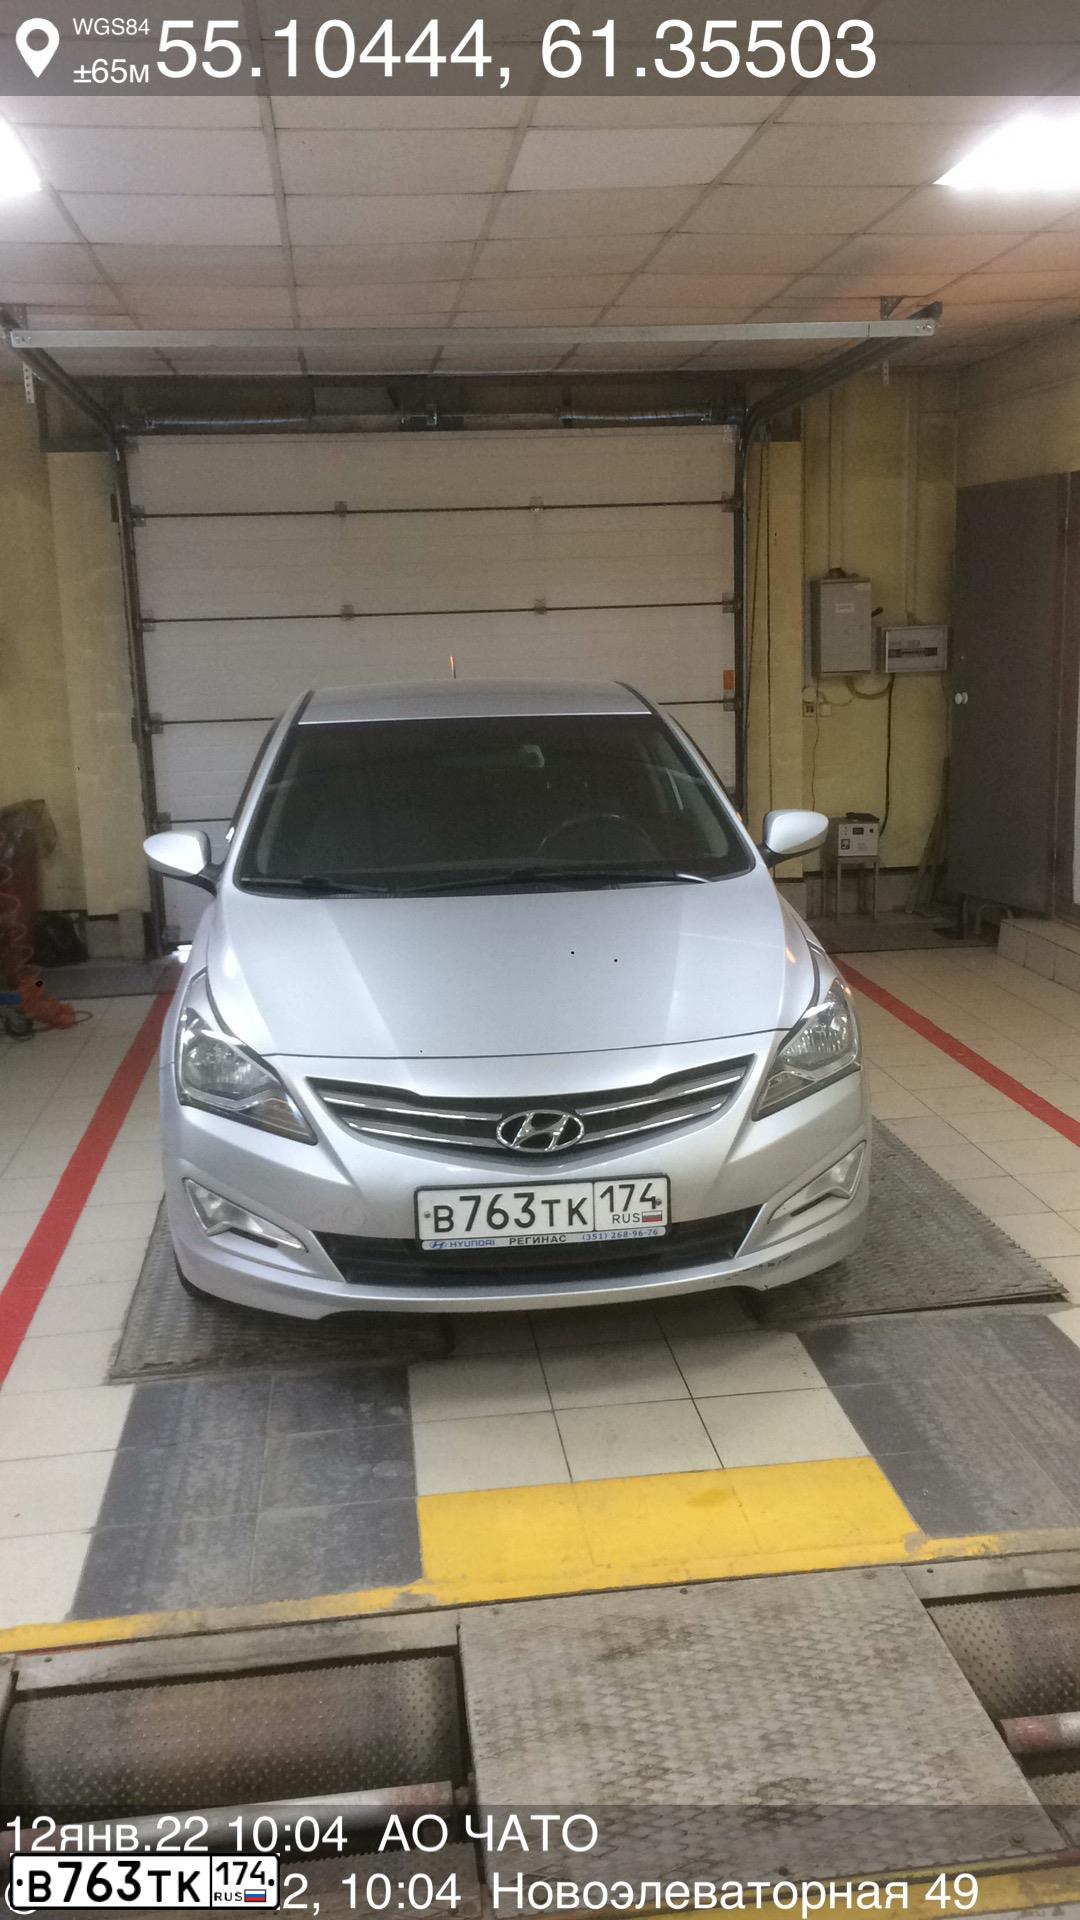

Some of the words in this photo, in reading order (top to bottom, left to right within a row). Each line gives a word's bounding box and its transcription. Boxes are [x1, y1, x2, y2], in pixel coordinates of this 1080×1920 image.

[433, 1192, 588, 1233] В763ТК
[600, 1182, 657, 1213] 174
[612, 1213, 640, 1224] RUS
[450, 1239, 496, 1248] HYUNDAI
[509, 1235, 567, 1246] РЕГИНАС
